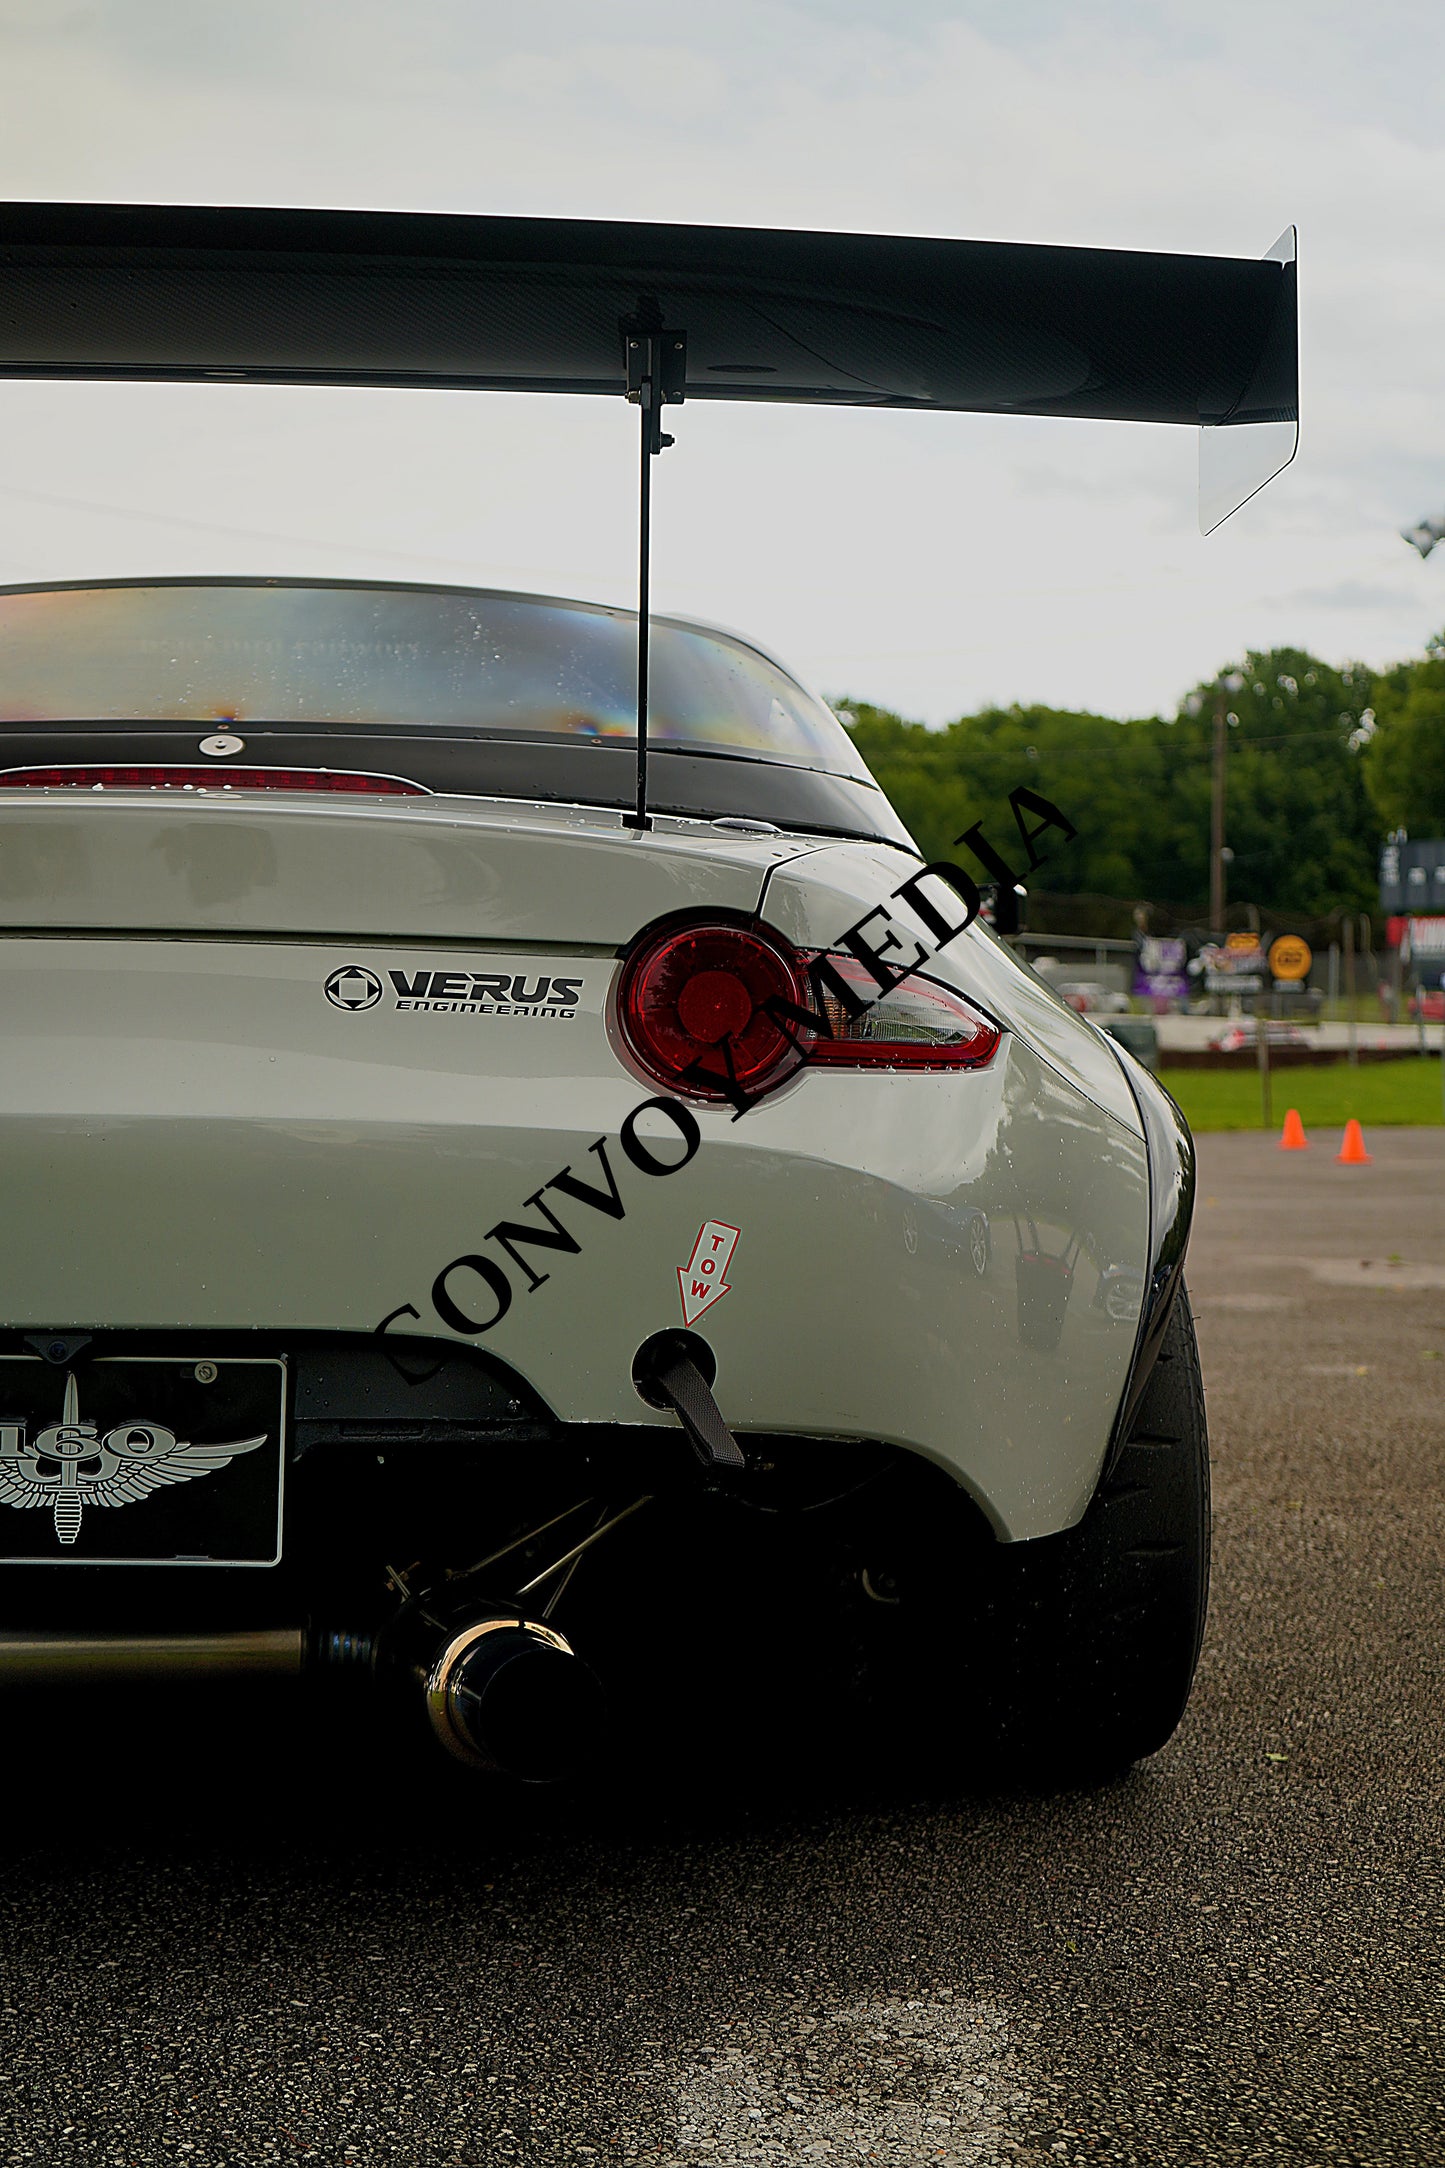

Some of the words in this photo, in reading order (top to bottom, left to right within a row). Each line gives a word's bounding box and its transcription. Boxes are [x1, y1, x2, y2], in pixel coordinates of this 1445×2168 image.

[388, 970, 584, 1006] VERUS
[395, 1000, 577, 1019] ENGINEERING
[691, 1234, 724, 1299] TOW
